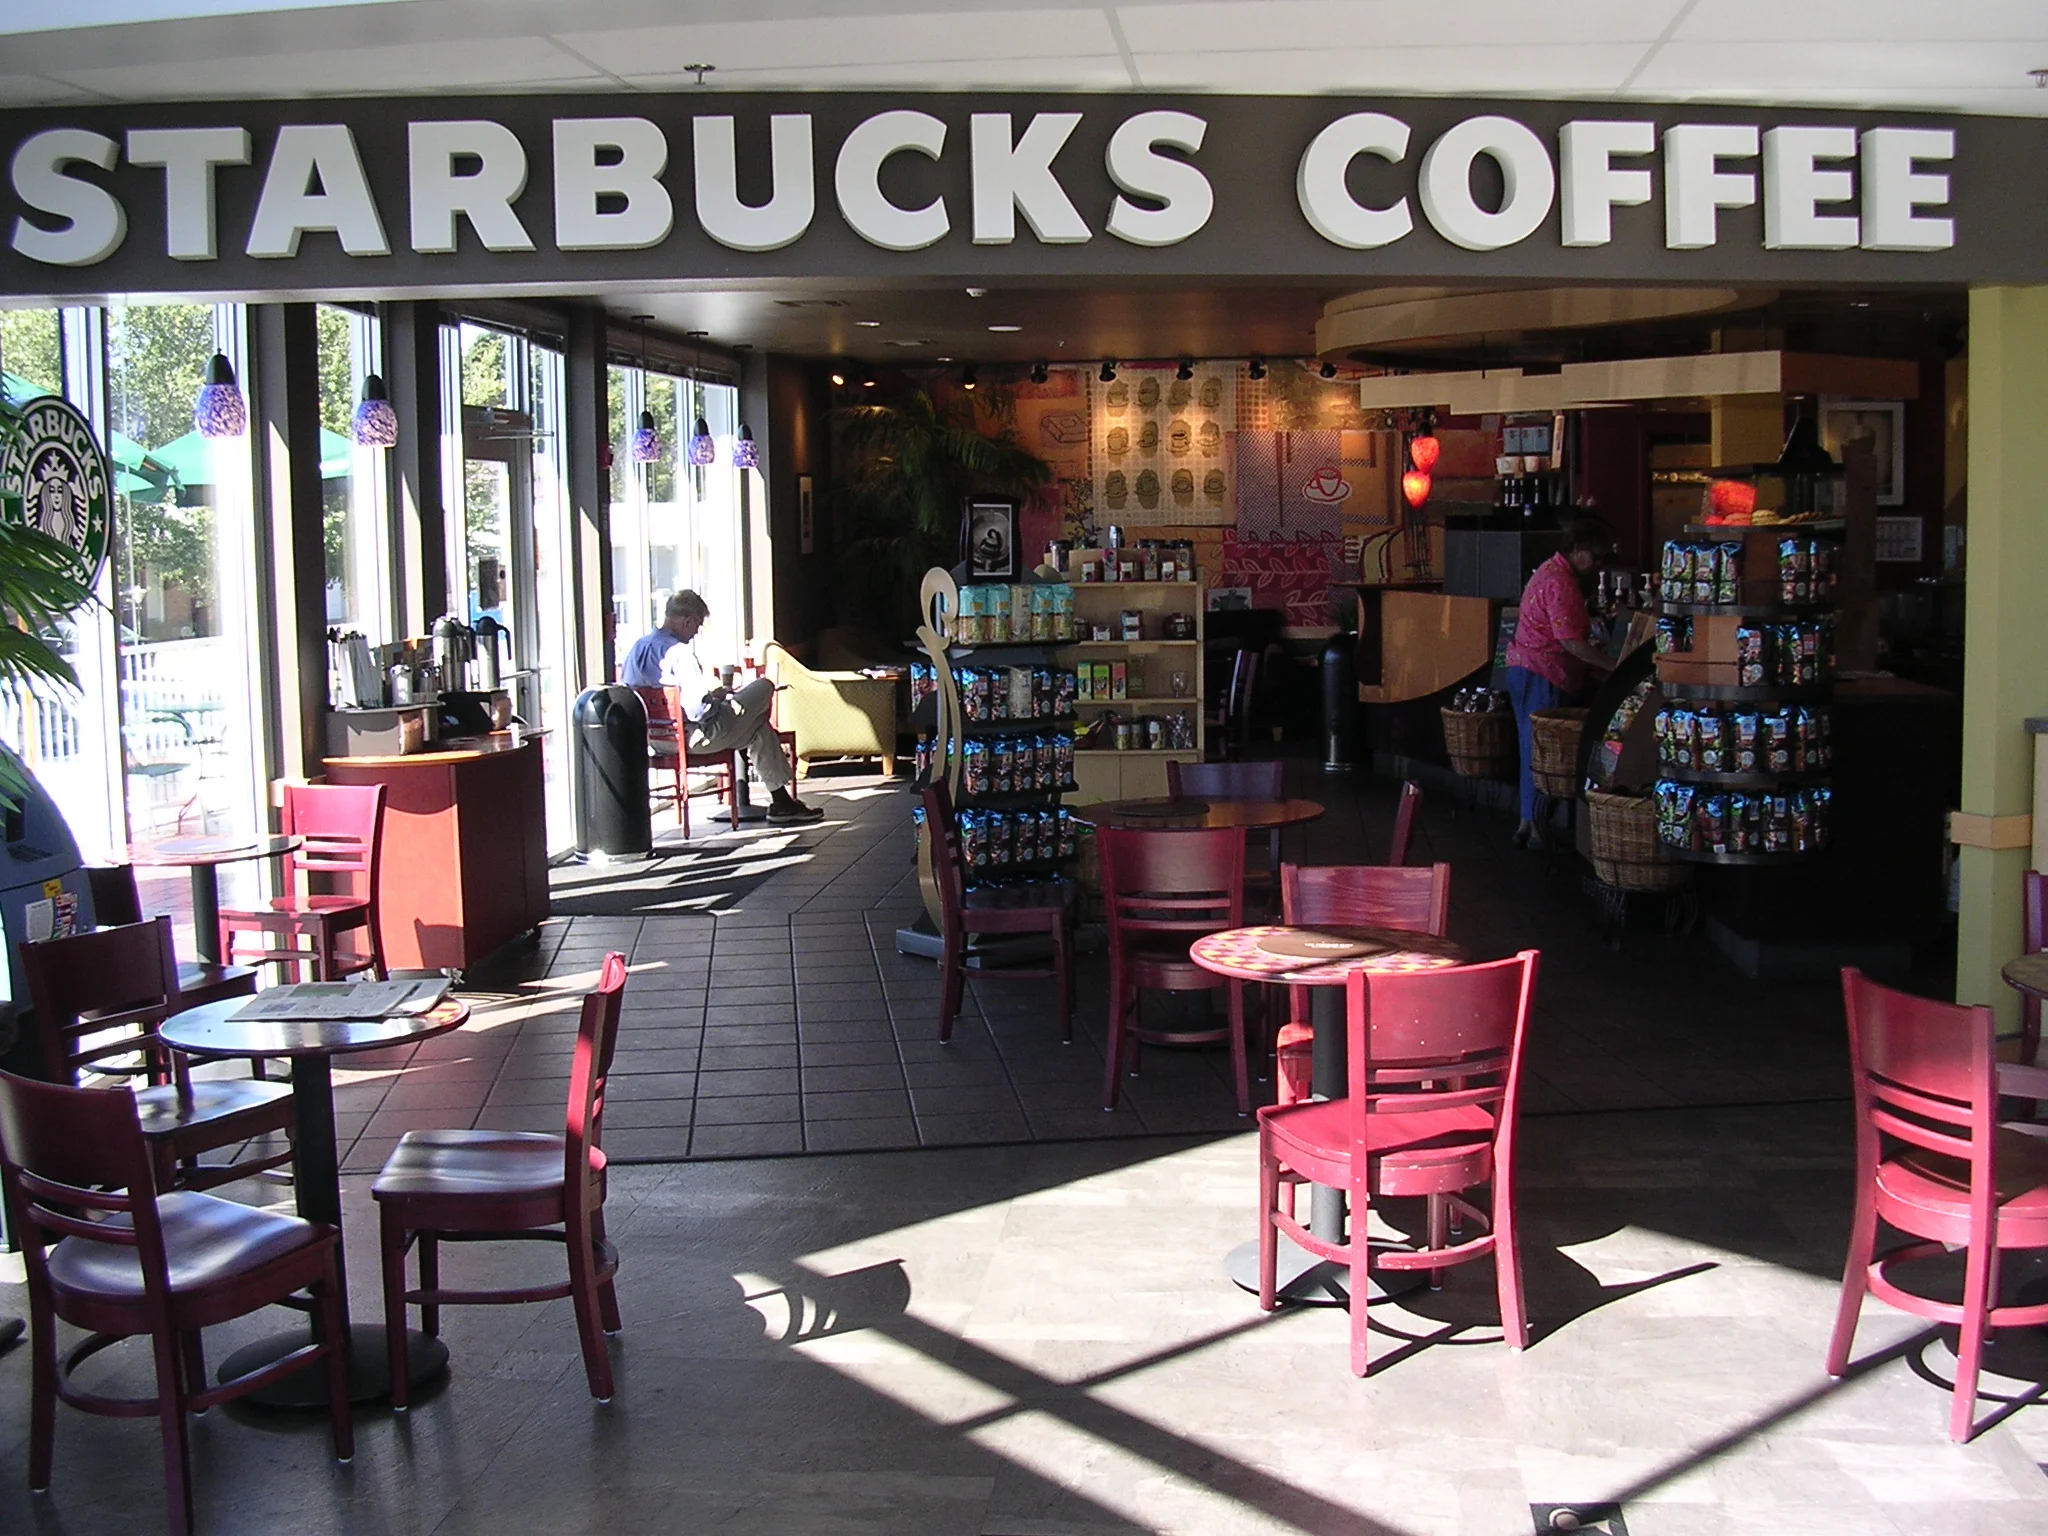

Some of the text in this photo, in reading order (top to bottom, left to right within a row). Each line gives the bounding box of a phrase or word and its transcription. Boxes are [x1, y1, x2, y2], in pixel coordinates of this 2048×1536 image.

[11, 110, 1957, 267] STARBUCKS COFFEE
[6, 408, 104, 501] STARBUCKS
